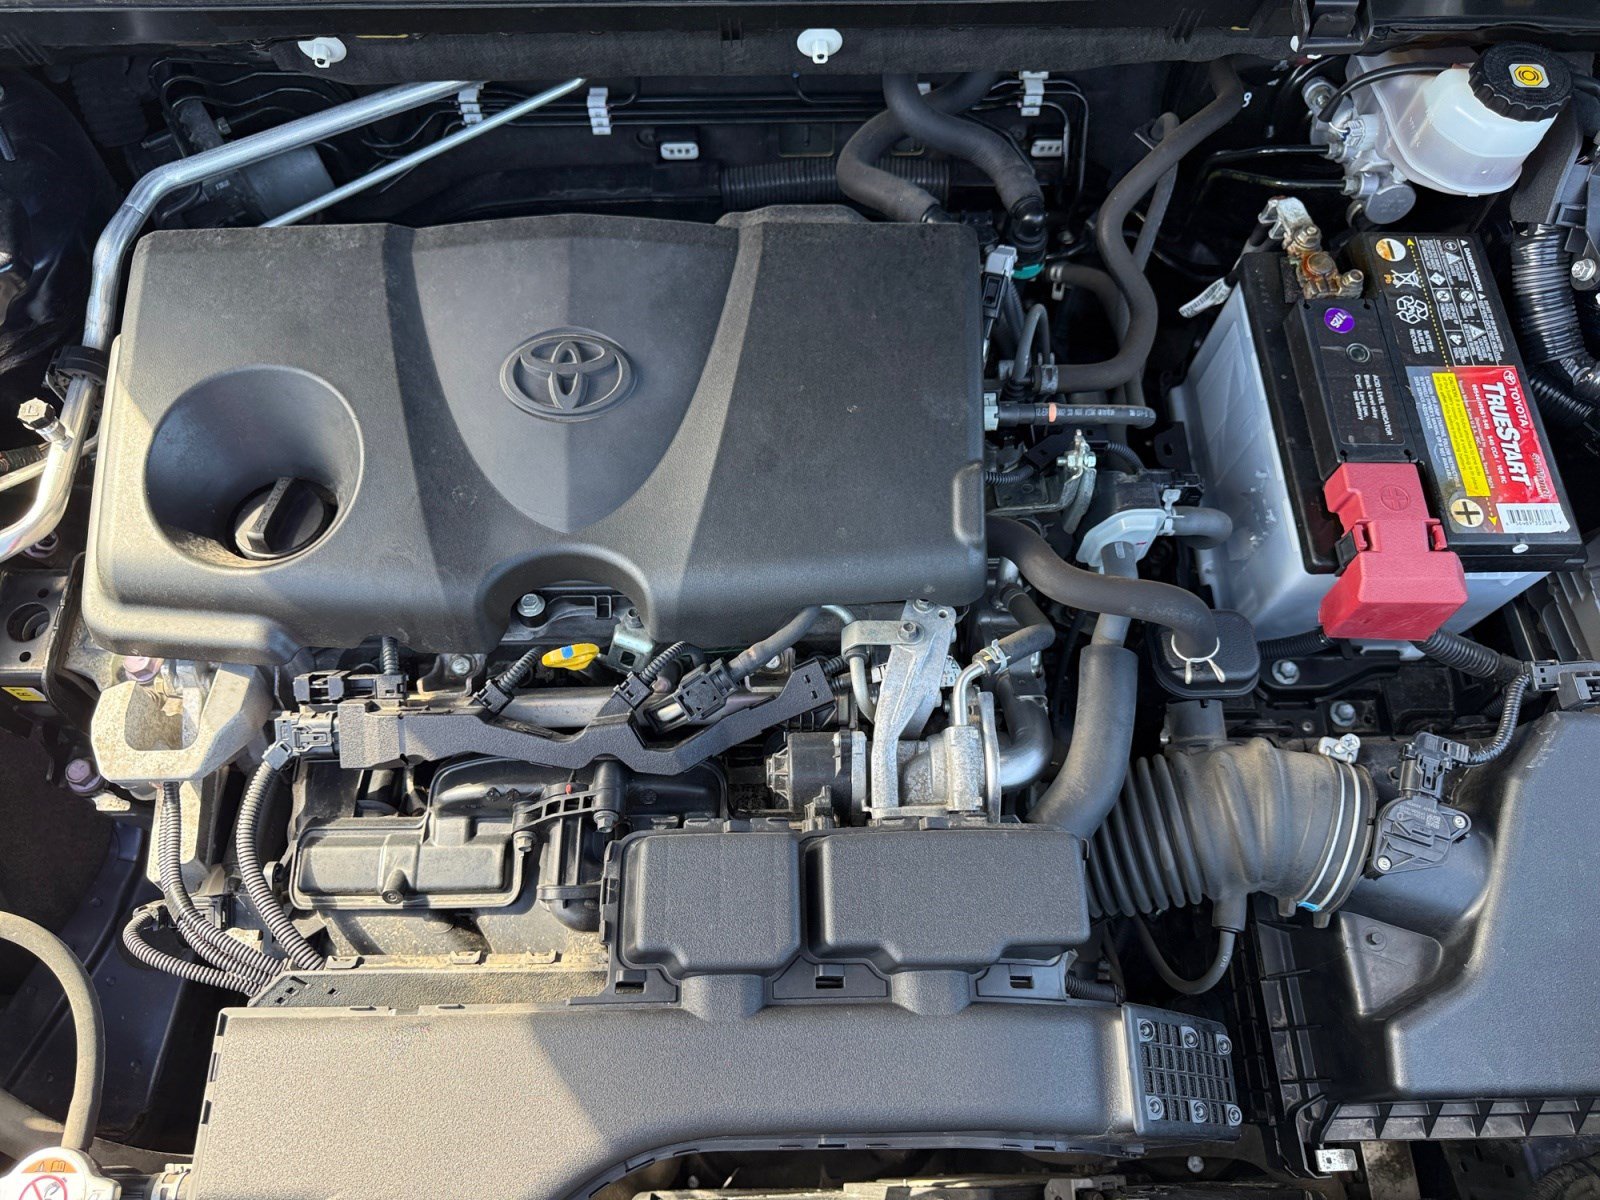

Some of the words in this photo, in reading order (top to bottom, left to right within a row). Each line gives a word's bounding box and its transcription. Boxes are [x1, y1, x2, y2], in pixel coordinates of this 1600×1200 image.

[1408, 328, 1421, 354] RECYCLED
[1416, 329, 1425, 344] MUST
[1423, 329, 1434, 352] BATTERY
[1372, 374, 1381, 387] ACID
[1376, 388, 1385, 404] LEVEL
[1508, 386, 1530, 426] TOYOTA
[1380, 405, 1393, 435] INDICATOR
